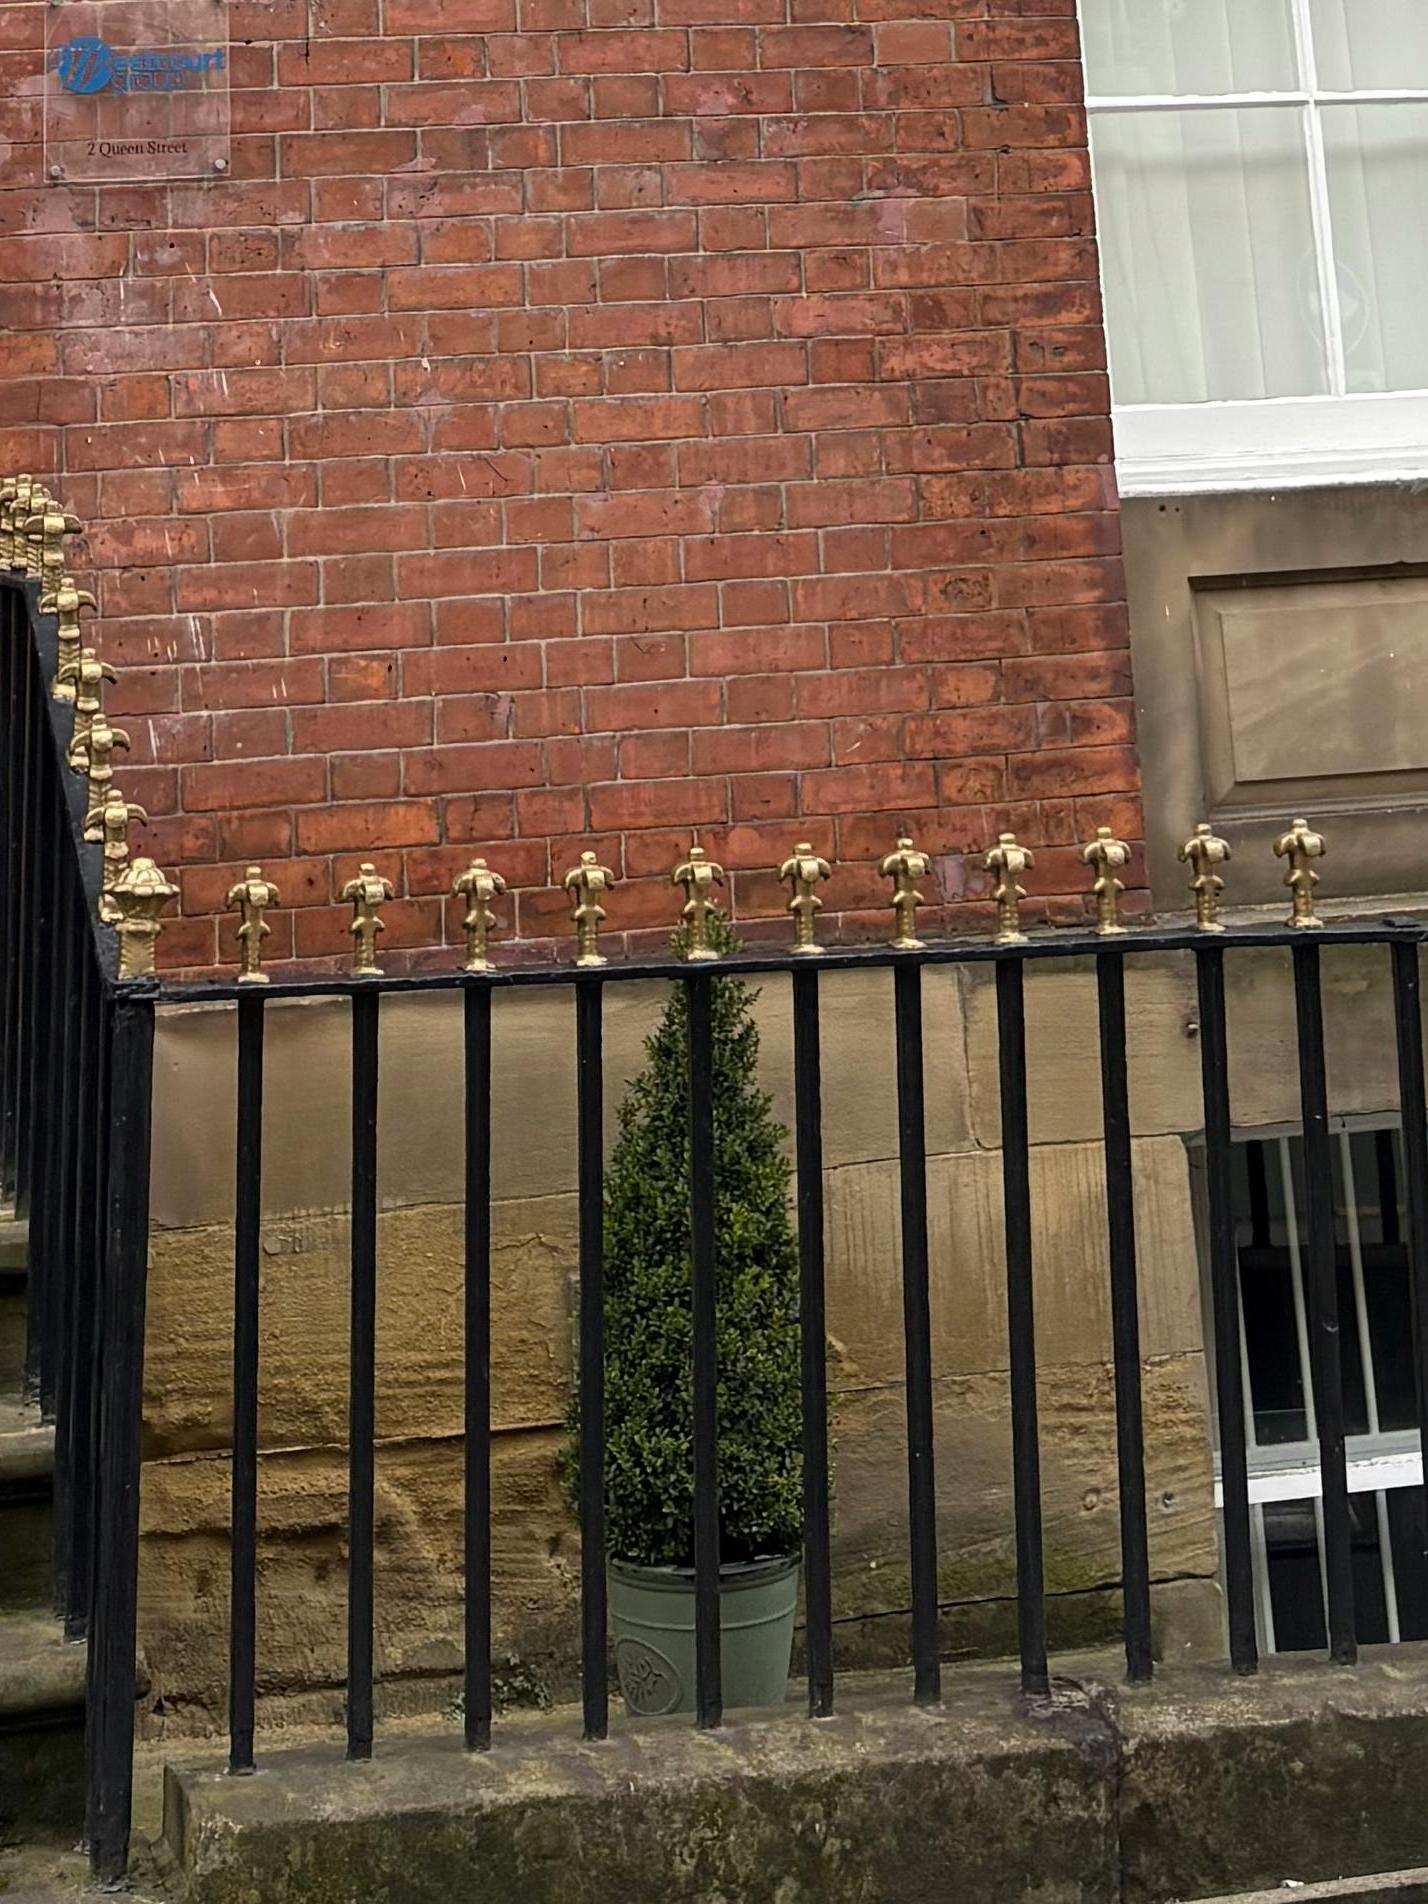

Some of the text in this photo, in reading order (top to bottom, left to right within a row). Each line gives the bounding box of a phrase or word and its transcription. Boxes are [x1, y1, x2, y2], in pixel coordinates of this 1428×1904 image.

[87, 141, 188, 158] 2 Queen Street
